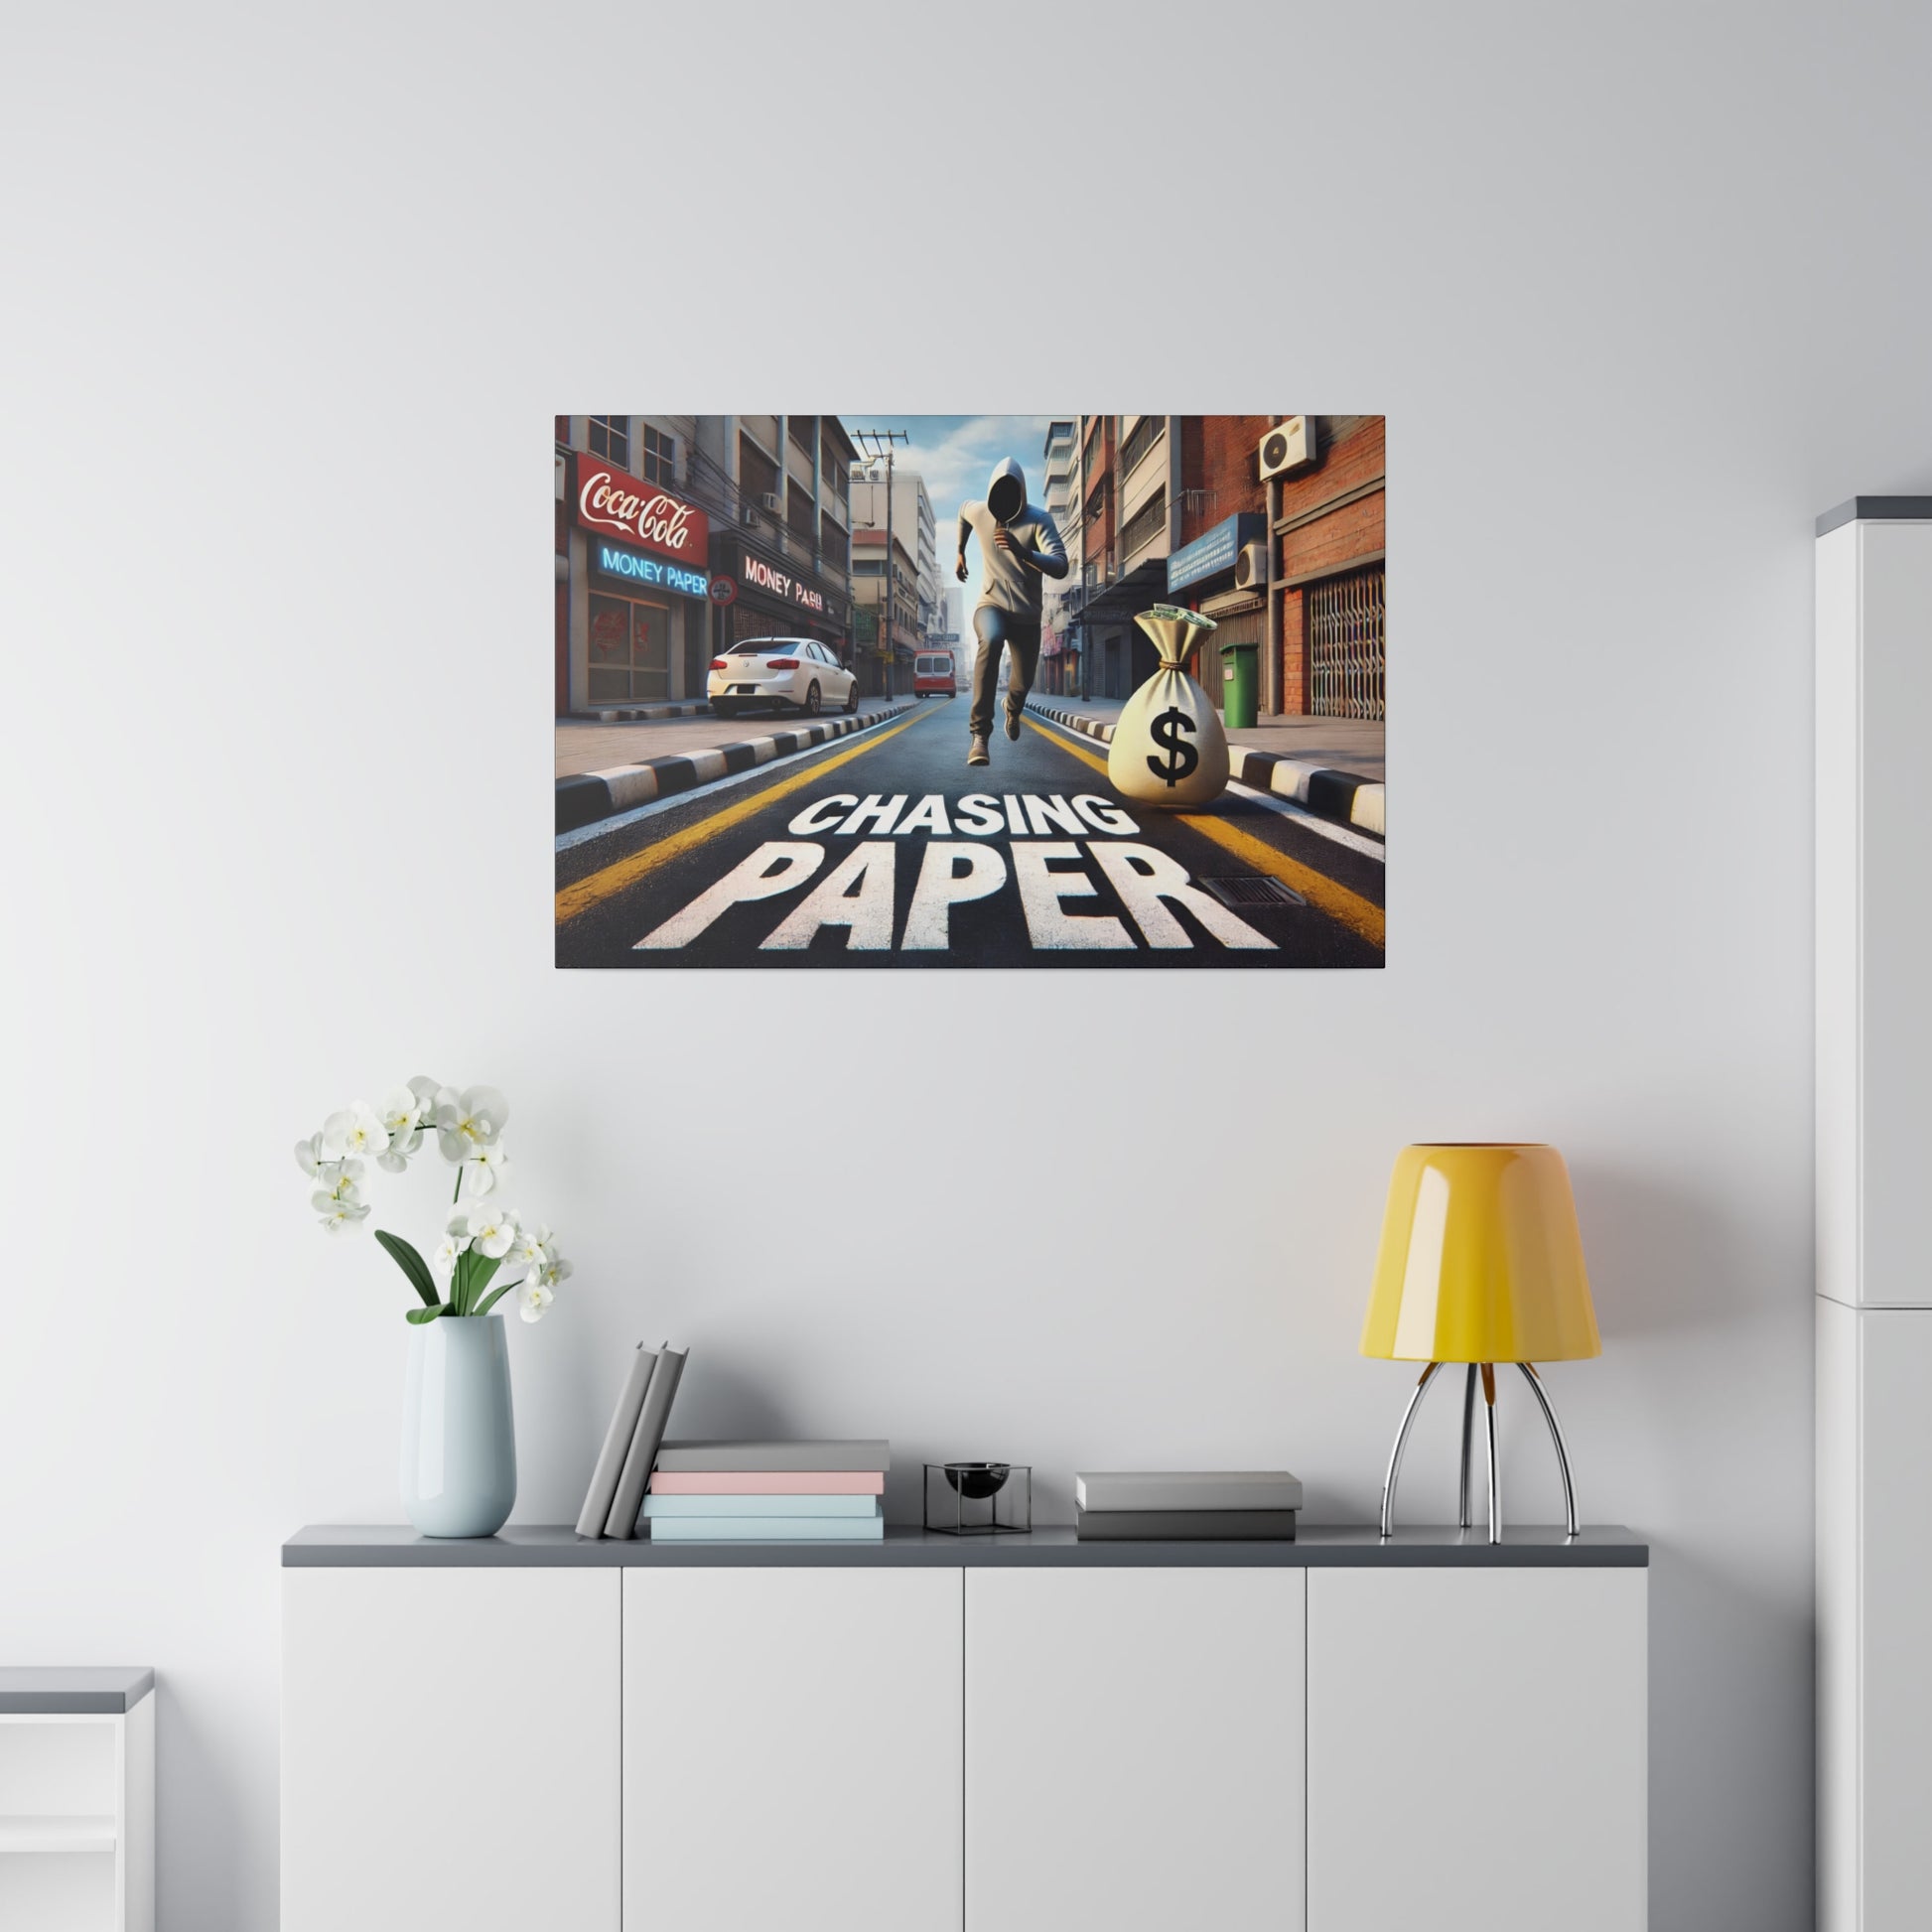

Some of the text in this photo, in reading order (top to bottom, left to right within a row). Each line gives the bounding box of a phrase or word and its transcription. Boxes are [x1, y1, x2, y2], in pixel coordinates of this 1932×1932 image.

[603, 548, 708, 596] MONEY PAPER
[745, 556, 791, 597] MONEY
[1147, 706, 1199, 787] $
[788, 794, 1141, 836] CHASING
[631, 841, 1281, 950] PAPER
